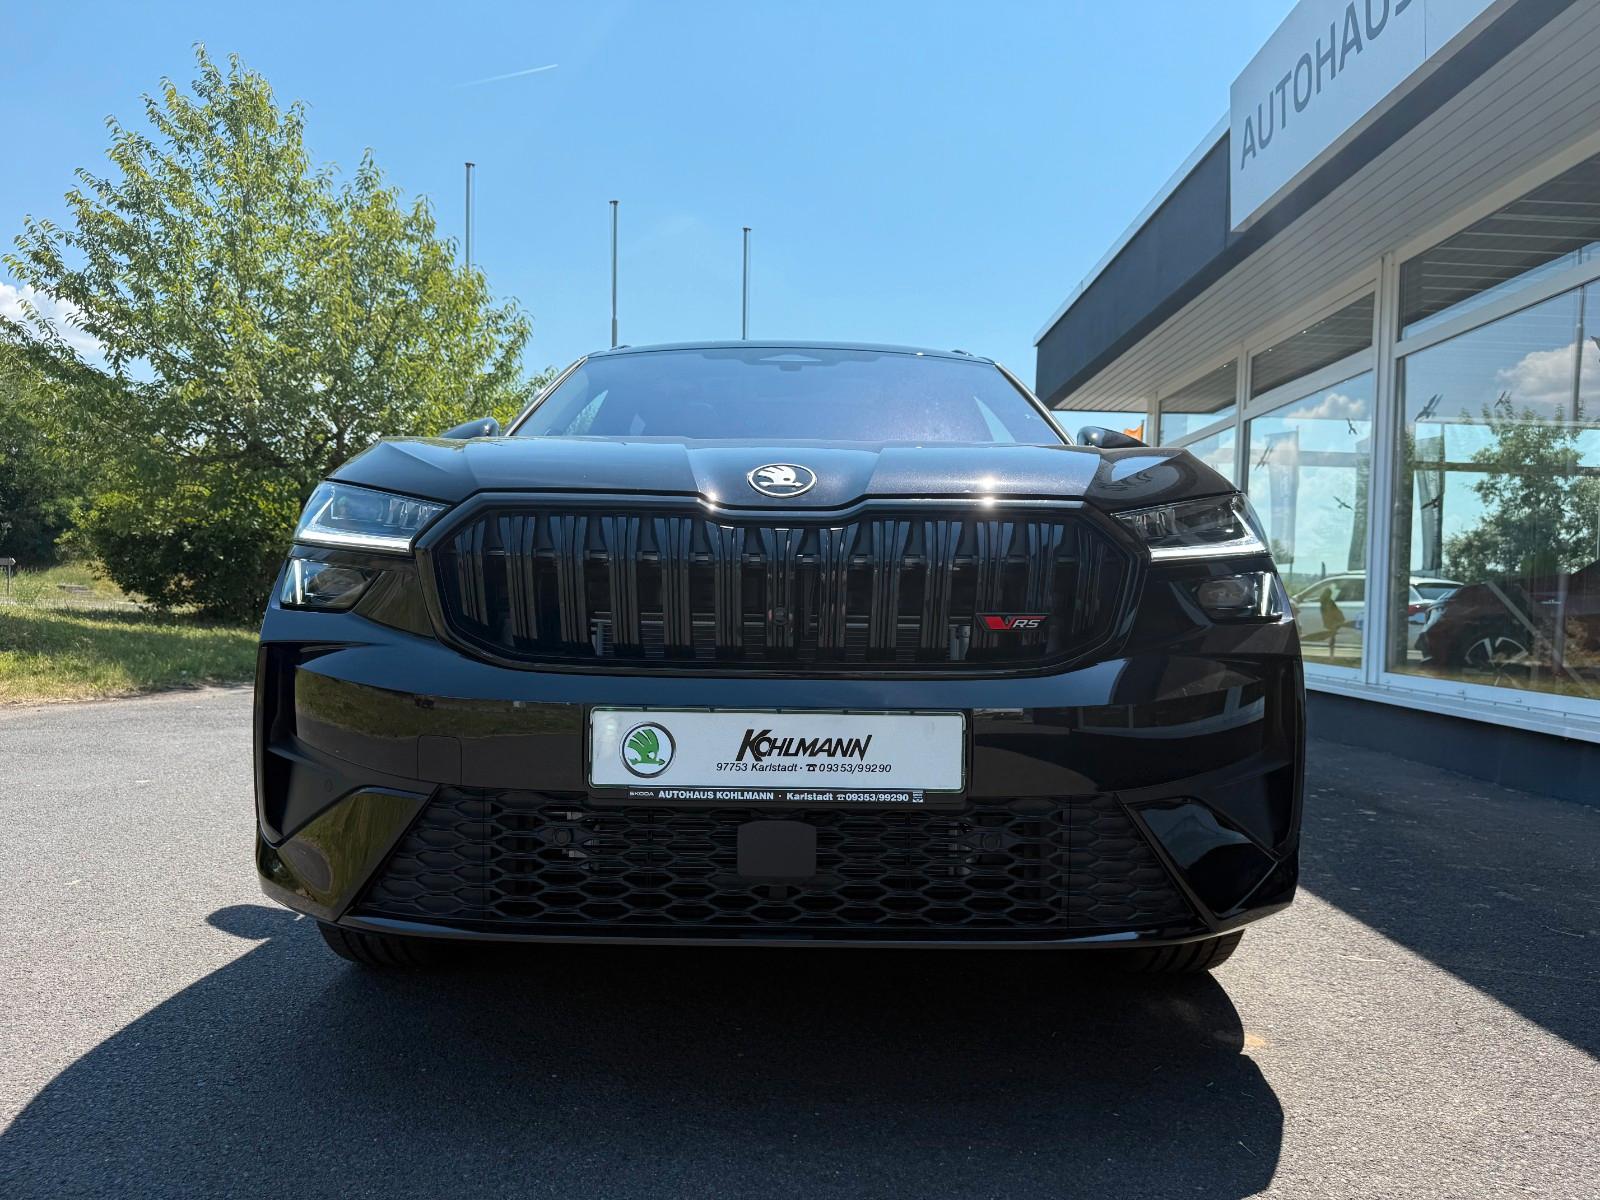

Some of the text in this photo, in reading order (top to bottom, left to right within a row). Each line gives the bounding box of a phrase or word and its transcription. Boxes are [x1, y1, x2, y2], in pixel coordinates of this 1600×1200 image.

[1240, 0, 1411, 170] AUTOHAU
[735, 729, 873, 762] KOHLMANN
[716, 762, 892, 774] 97753 Karlstadt 09353/99290
[658, 790, 714, 799] AUTOHAUS
[716, 790, 774, 800] KOHLMANN
[786, 792, 833, 801] Karlstadt
[845, 793, 909, 802] 09353/99290
